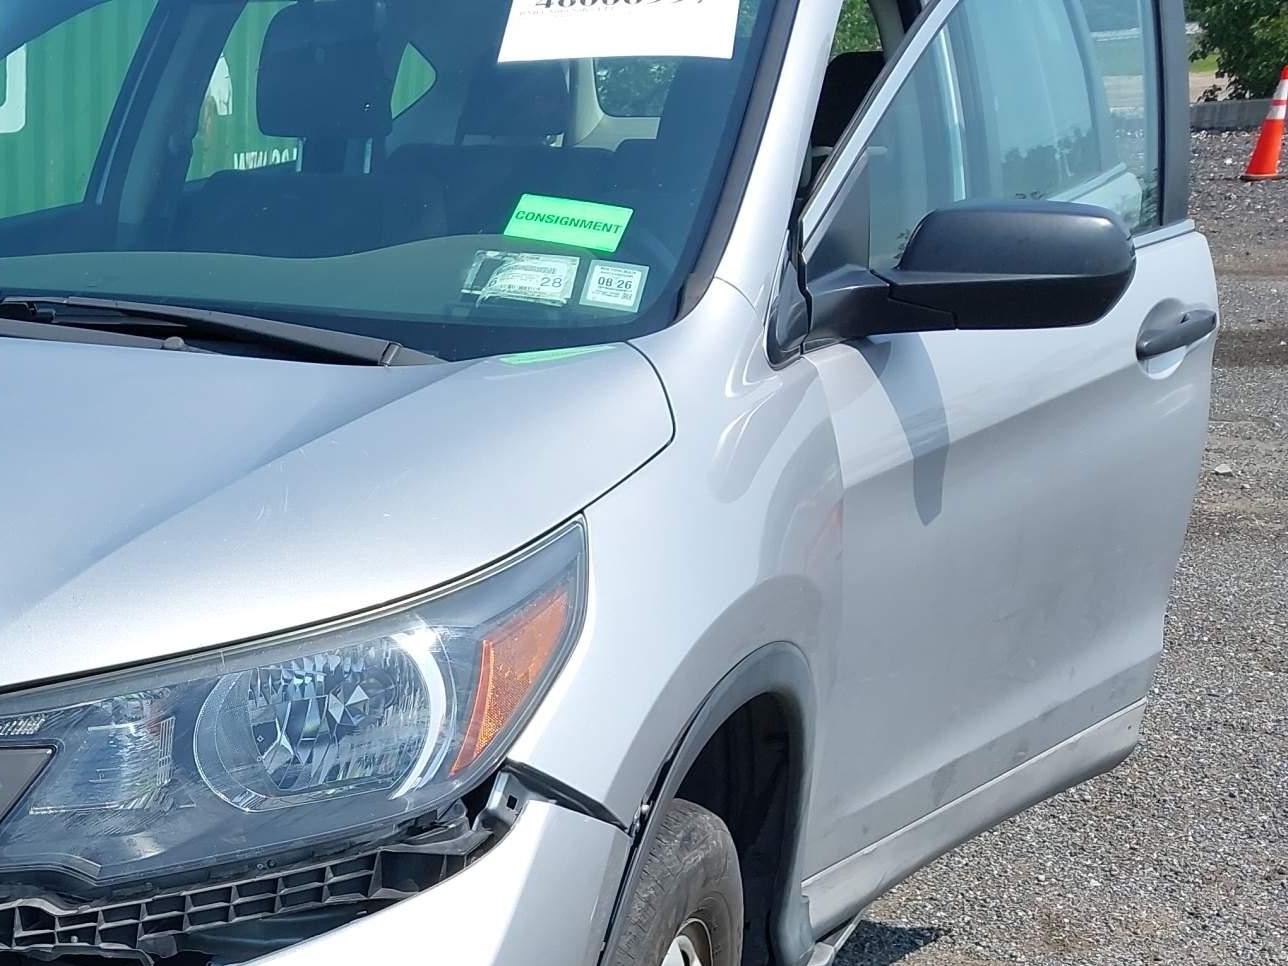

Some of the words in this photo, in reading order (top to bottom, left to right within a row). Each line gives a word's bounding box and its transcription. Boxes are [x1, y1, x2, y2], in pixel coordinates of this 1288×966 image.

[514, 210, 623, 235] CONSIGNMENT
[540, 276, 562, 288] 28
[597, 276, 614, 287] 08
[616, 279, 633, 290] 26
